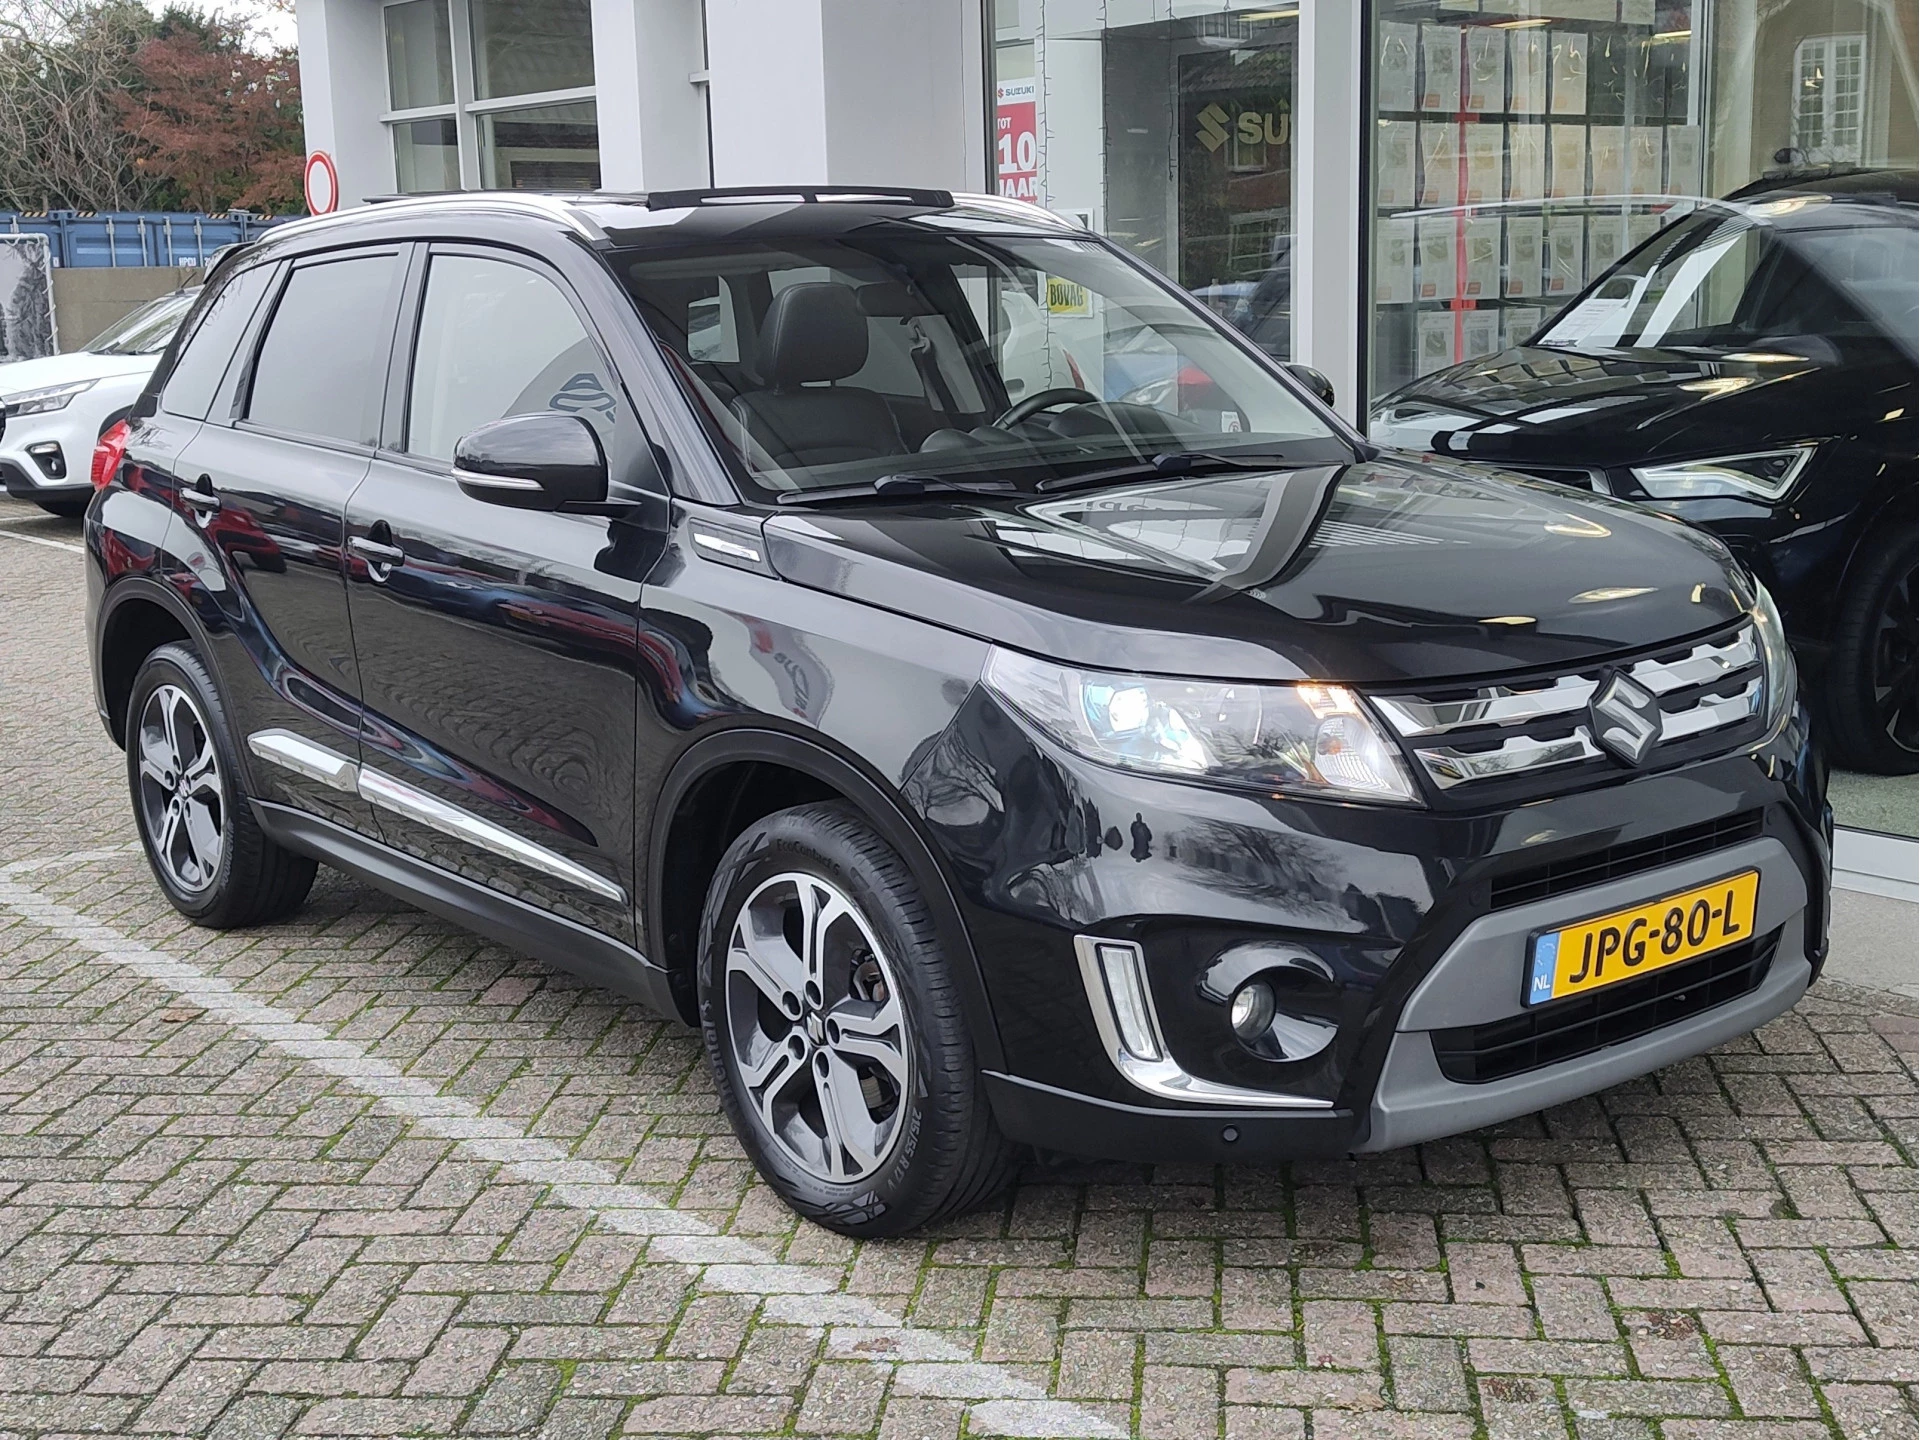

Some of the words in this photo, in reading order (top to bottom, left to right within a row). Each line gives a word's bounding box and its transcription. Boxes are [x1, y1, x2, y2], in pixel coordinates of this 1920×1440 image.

[1005, 85, 1035, 96] SUZUKI
[1238, 111, 1290, 145] SU
[999, 131, 1037, 172] 10
[1049, 283, 1084, 307] BOVAG
[1568, 889, 1740, 985] JPG-80-L
[1533, 974, 1551, 992] NL
